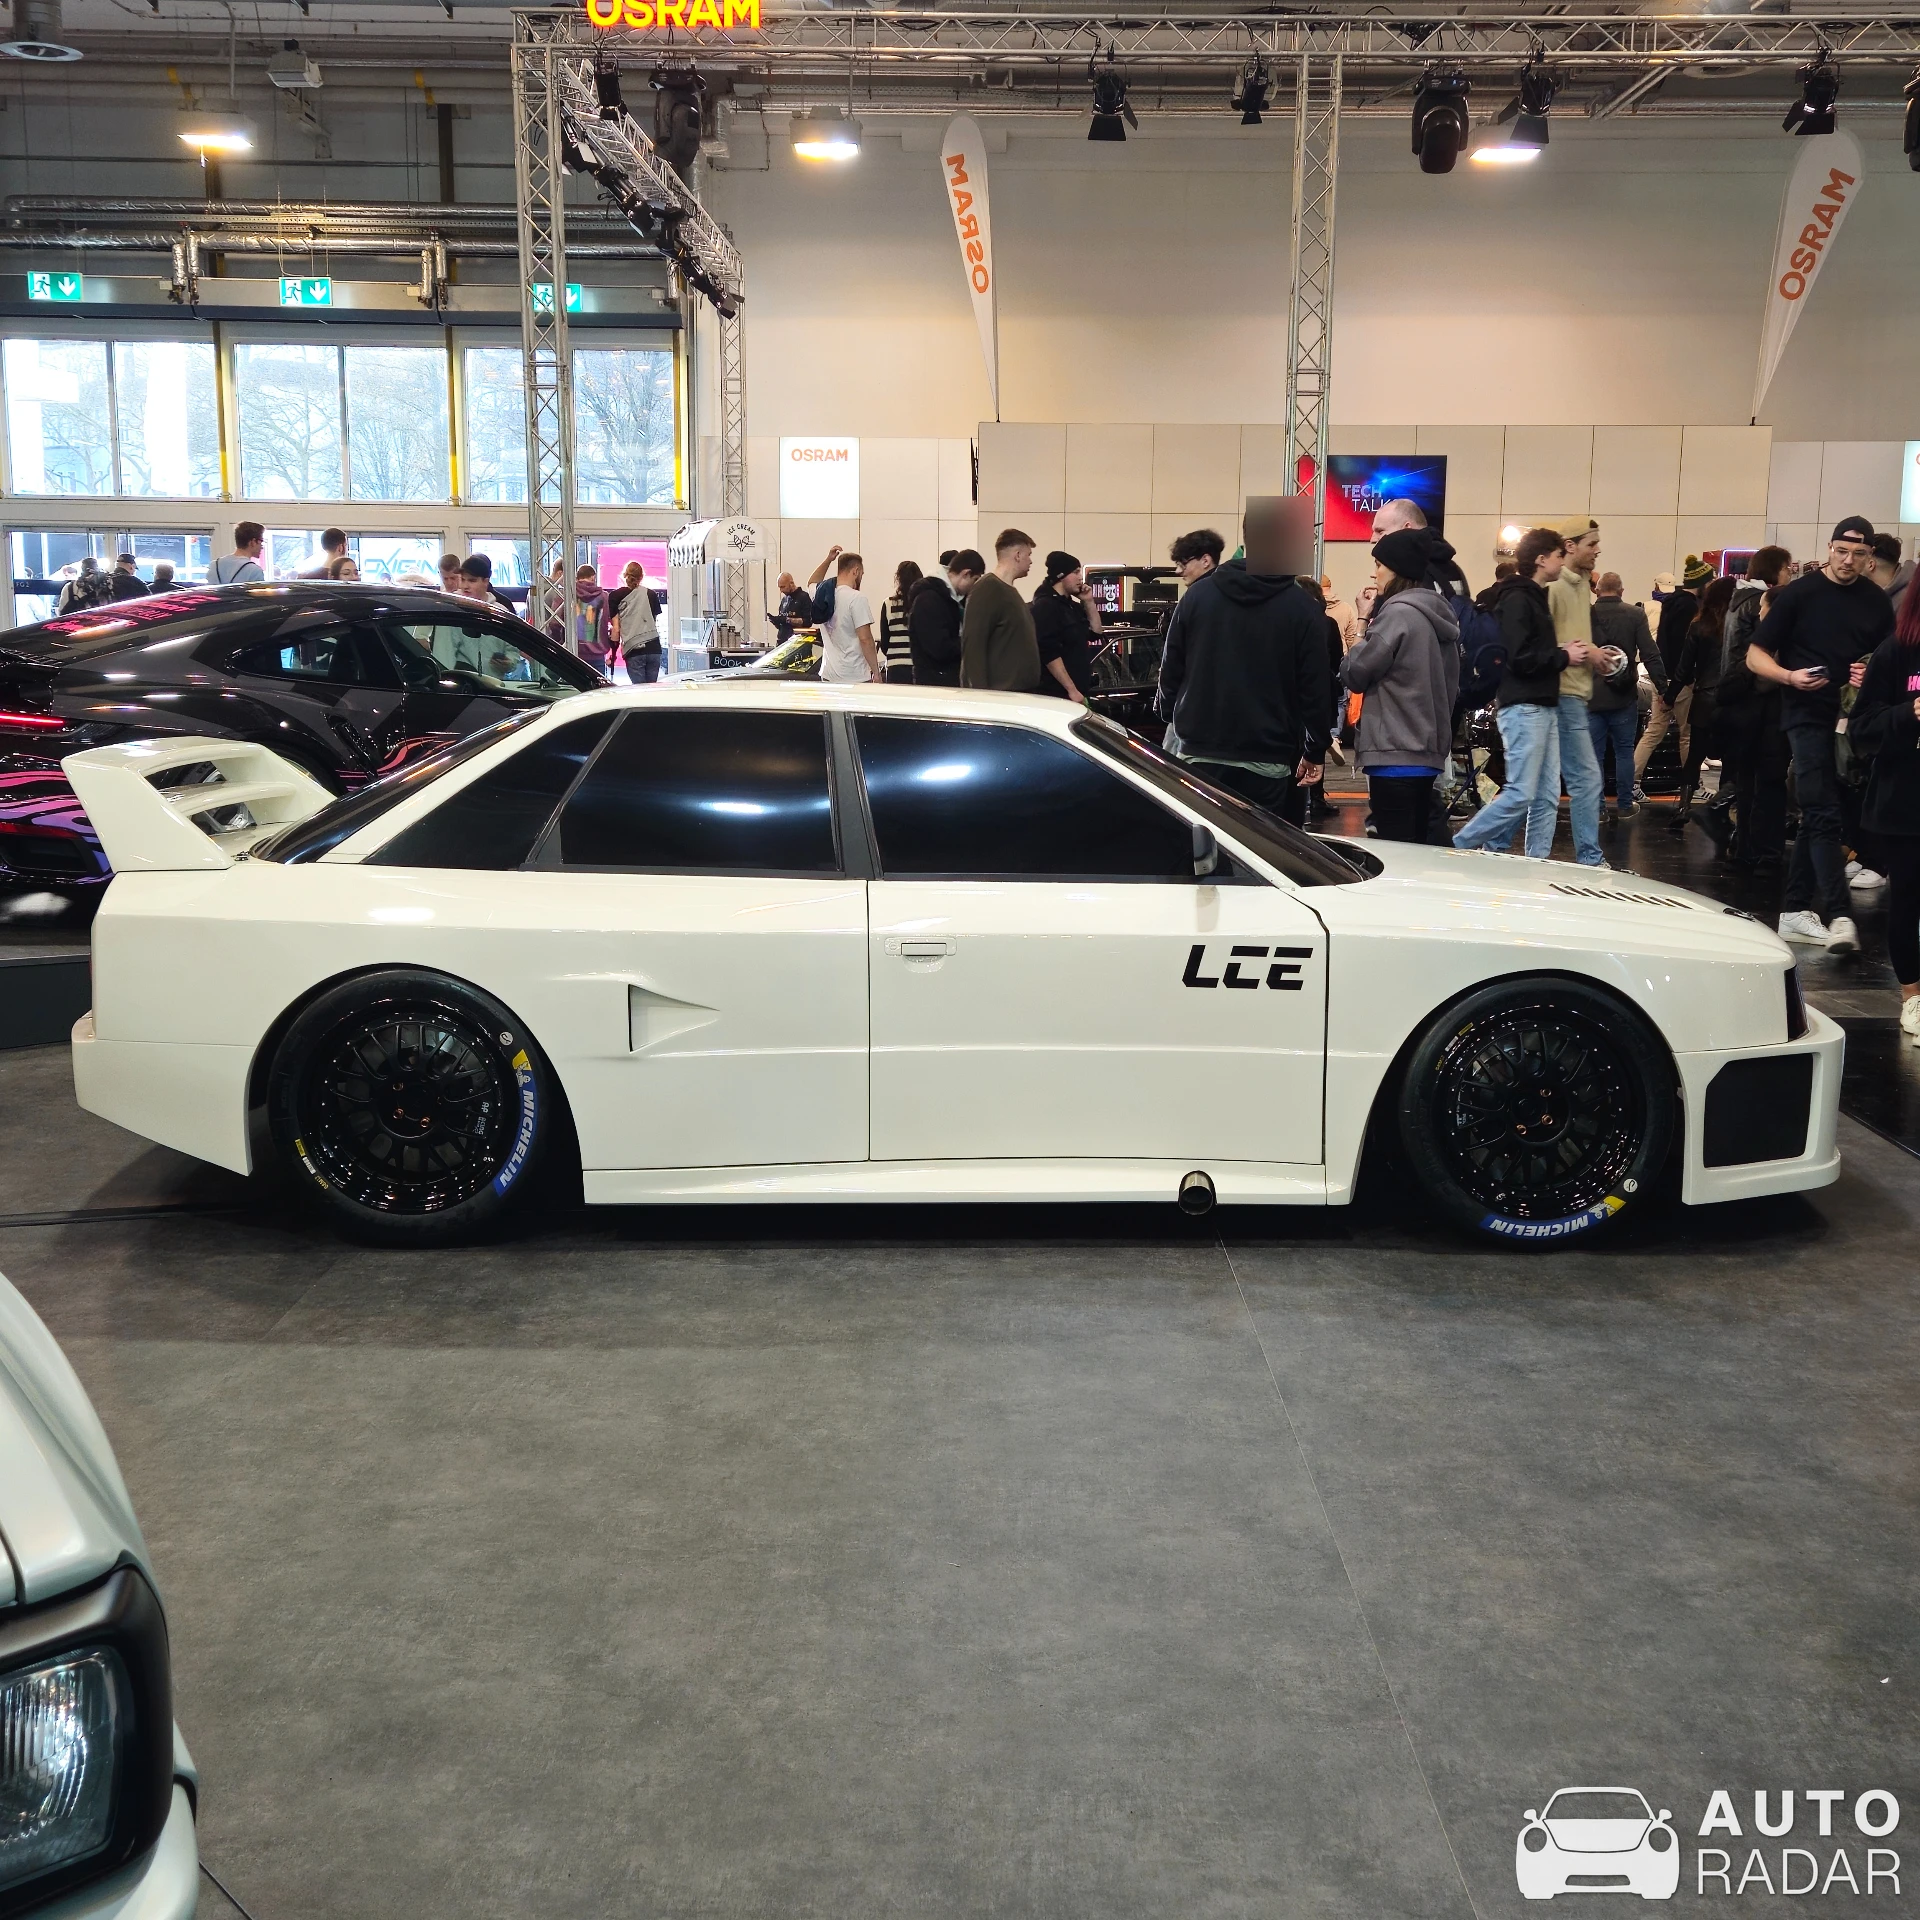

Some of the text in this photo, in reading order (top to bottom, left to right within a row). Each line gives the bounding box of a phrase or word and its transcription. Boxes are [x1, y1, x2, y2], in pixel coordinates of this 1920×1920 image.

[586, 0, 761, 28] OSRAM
[1779, 167, 1856, 301] OSRAM
[791, 448, 849, 462] OSRAM
[1341, 484, 1382, 498] TECH
[1352, 499, 1396, 512] TALK
[726, 523, 756, 536] ICE CREAM
[1182, 944, 1314, 991] LCE
[500, 1089, 534, 1188] MICHELIN
[1489, 1214, 1589, 1237] MICHELIN
